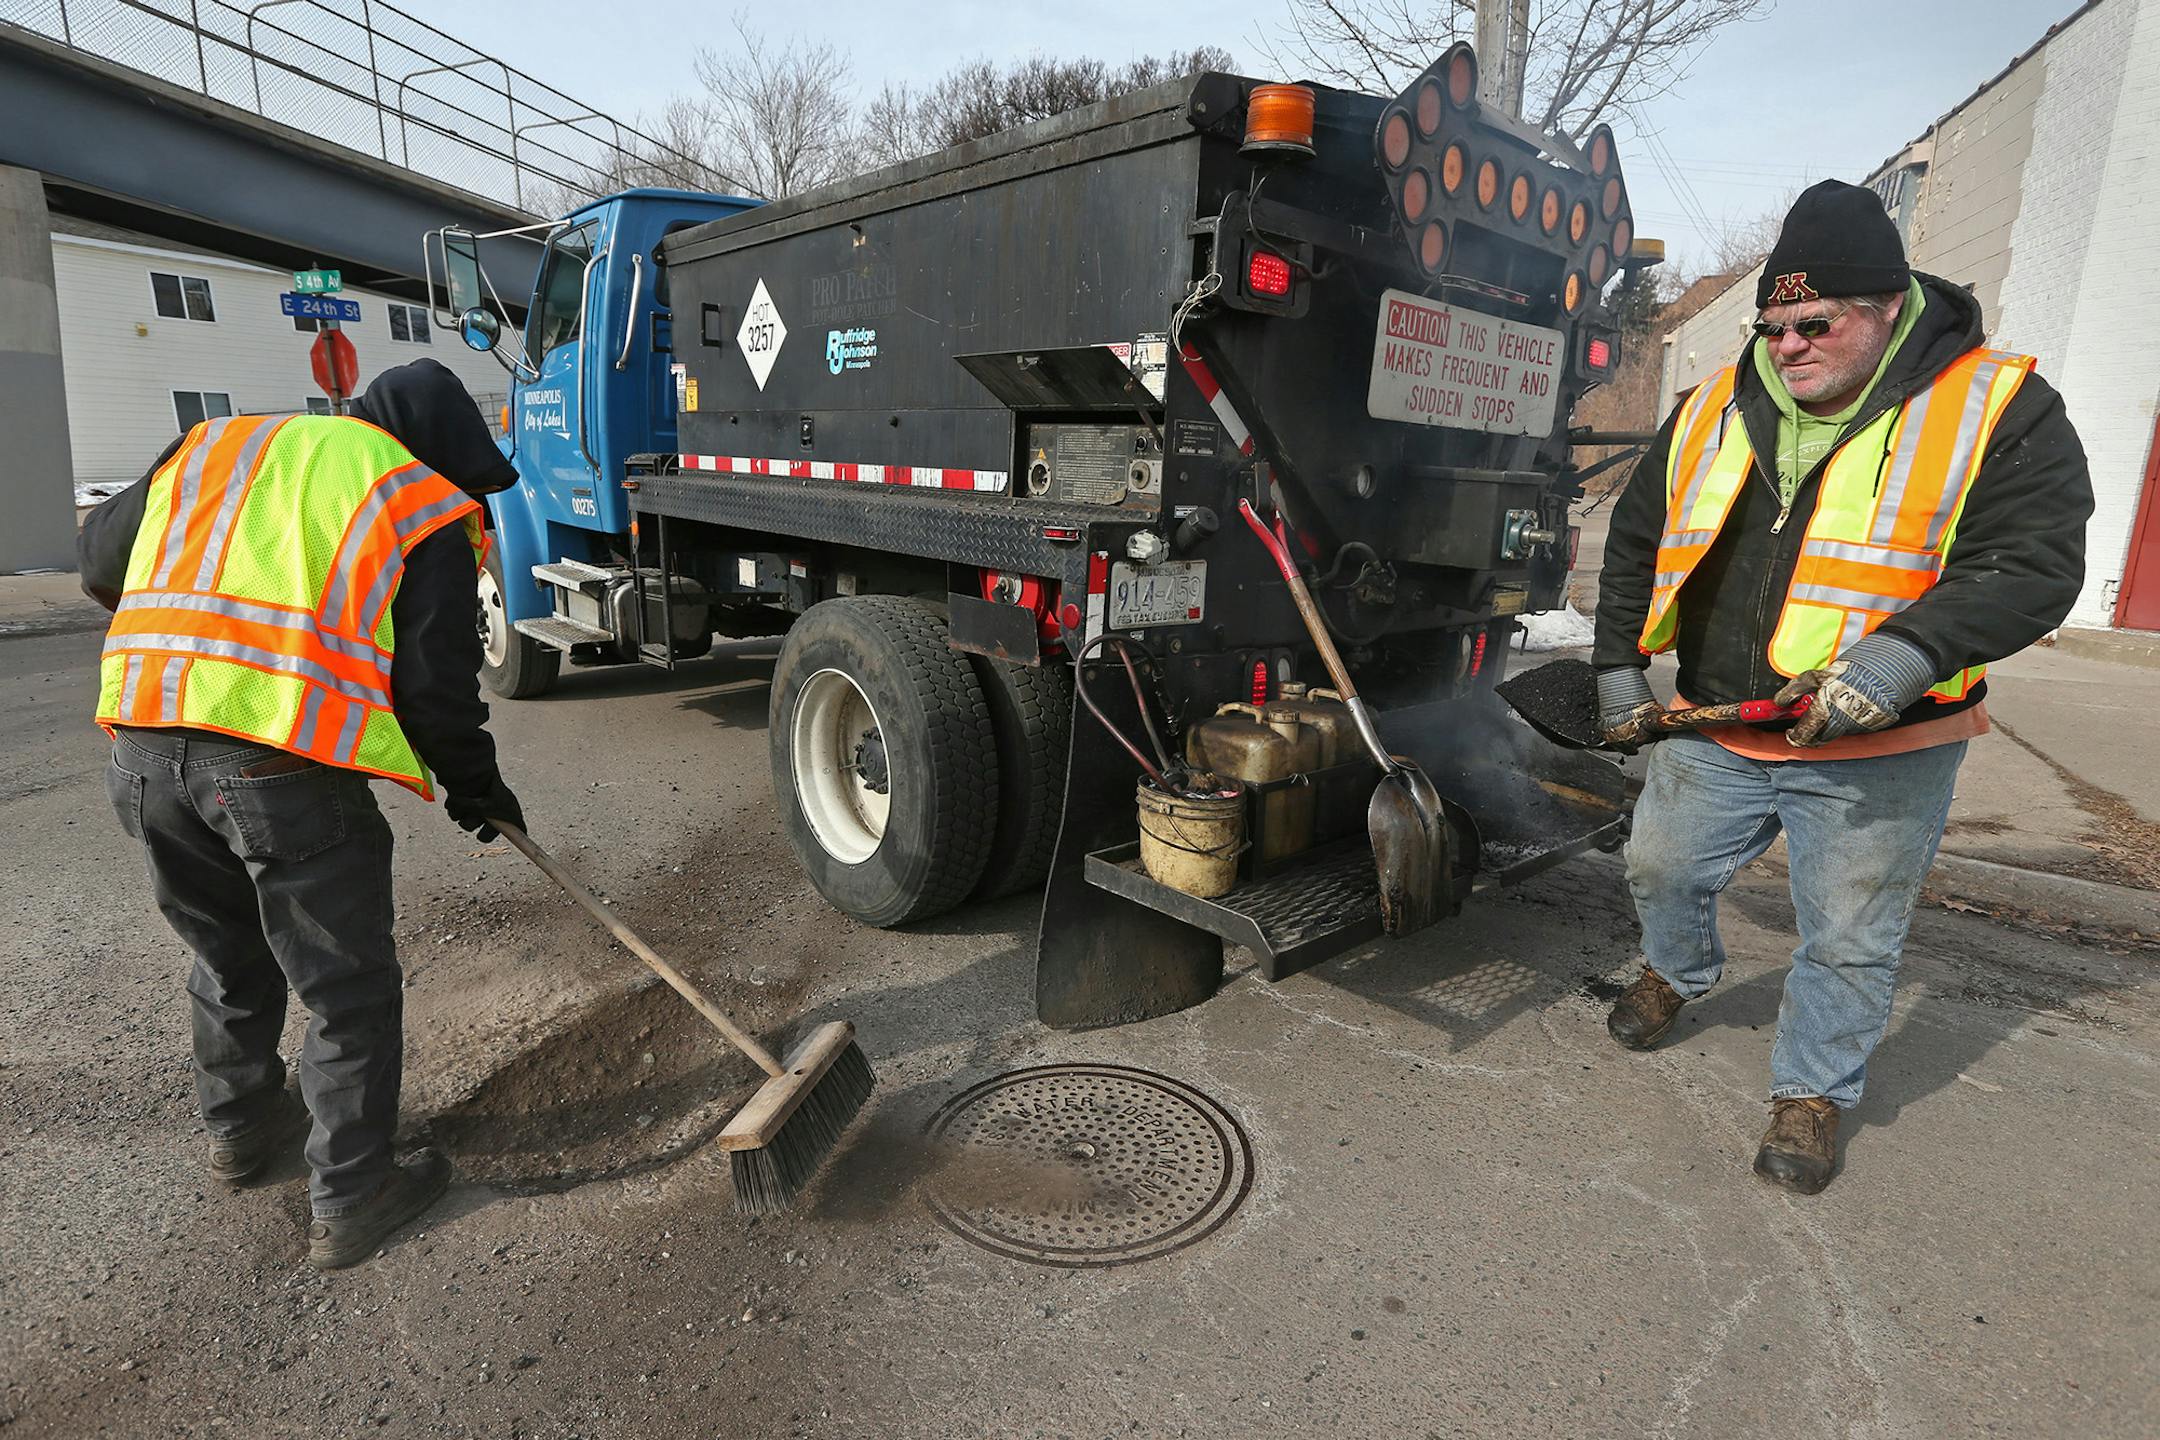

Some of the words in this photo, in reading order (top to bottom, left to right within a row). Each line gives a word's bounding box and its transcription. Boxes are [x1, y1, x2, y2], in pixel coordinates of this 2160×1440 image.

[296, 275, 303, 289] S
[306, 274, 323, 288] 4th
[328, 274, 339, 288] Av
[812, 275, 841, 307] PRO
[1768, 272, 1819, 304] M
[283, 298, 294, 312] E
[302, 300, 337, 316] 24th
[344, 304, 359, 317] St
[752, 302, 770, 322] HOT
[748, 323, 775, 353] 3257
[1388, 304, 1450, 346] CAUTION
[1458, 321, 1488, 353] THIS
[1498, 331, 1556, 367] VEHICLE
[1384, 341, 1433, 378] MAKES
[1441, 354, 1510, 392] FREQUENT
[1519, 370, 1550, 398] AND
[524, 389, 561, 405] MINNEAPOLIS
[1409, 384, 1464, 419] SUDDEN
[1471, 395, 1516, 425] STOPS
[524, 409, 536, 431] City
[537, 410, 543, 432] of
[543, 408, 561, 427] Lakes
[571, 497, 596, 517] 00275
[1117, 576, 1201, 612] 914-459
[1013, 1096, 1094, 1119] WATER
[1122, 1105, 1180, 1204] DEPARTMENT
